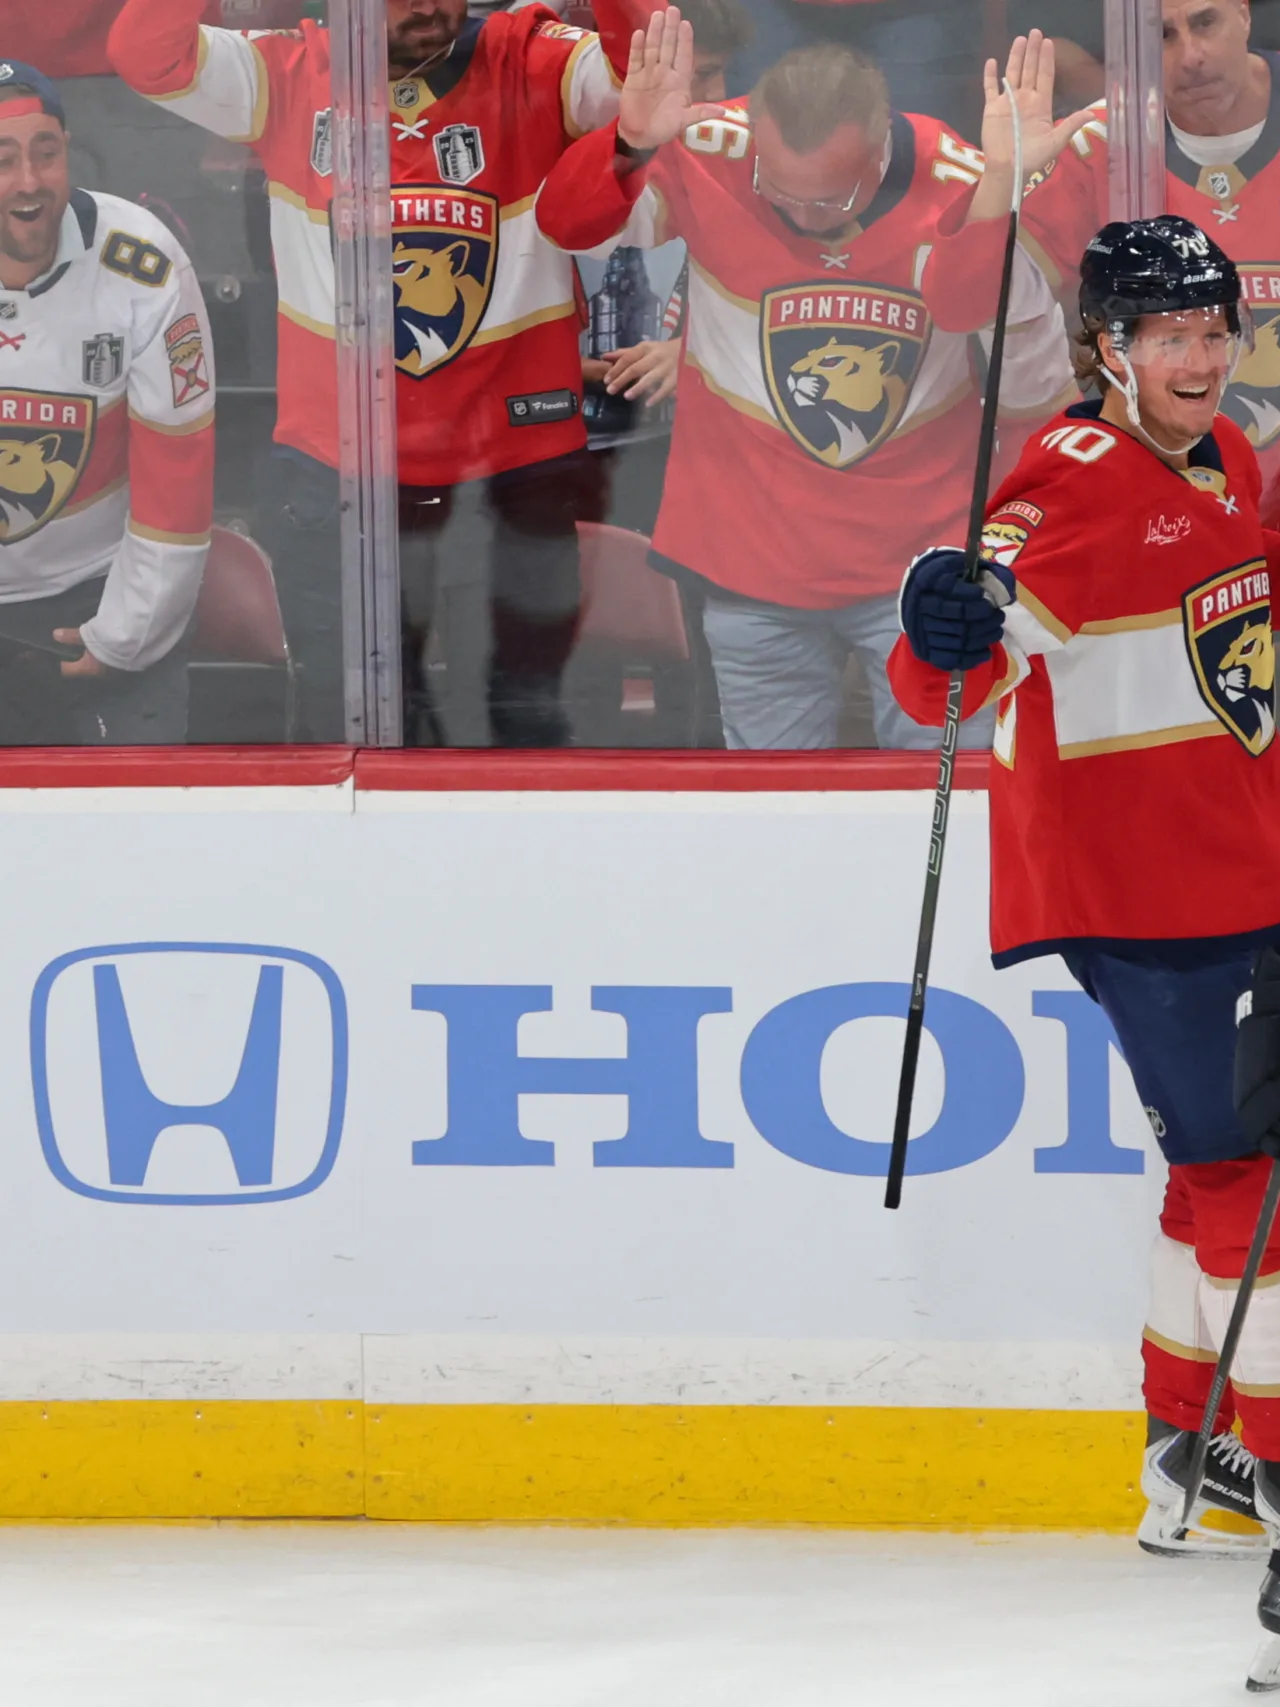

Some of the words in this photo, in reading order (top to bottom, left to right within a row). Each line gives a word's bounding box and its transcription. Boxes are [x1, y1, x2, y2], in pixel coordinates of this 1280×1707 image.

[391, 198, 483, 229] THERS
[100, 229, 174, 288] 8
[780, 295, 917, 331] PANTHERS
[1202, 572, 1270, 622] PANTHE
